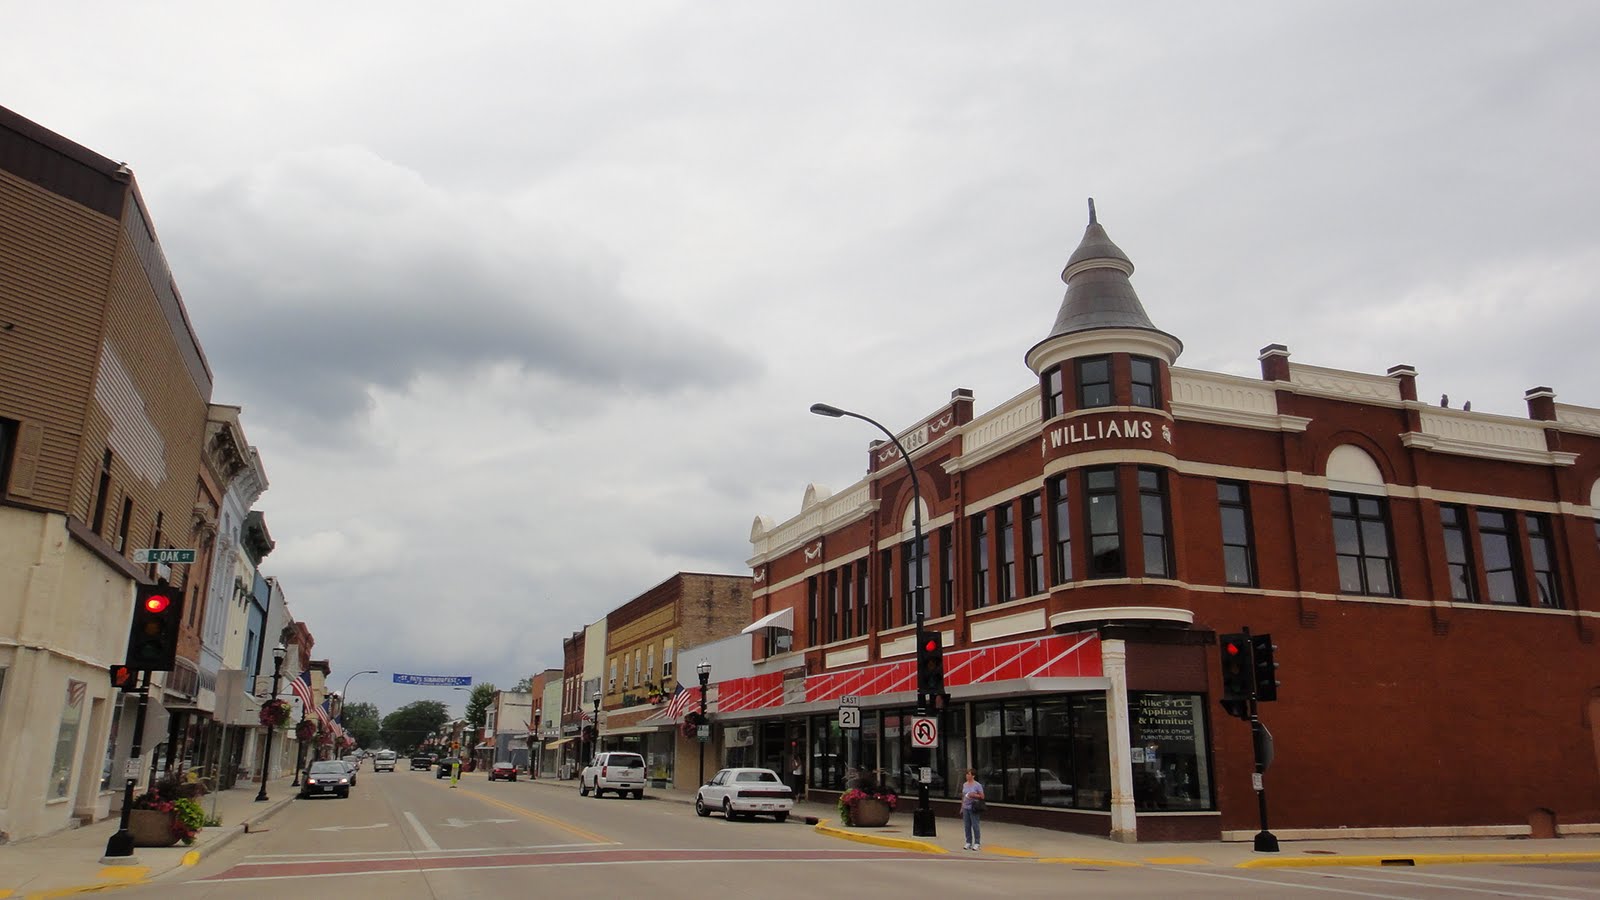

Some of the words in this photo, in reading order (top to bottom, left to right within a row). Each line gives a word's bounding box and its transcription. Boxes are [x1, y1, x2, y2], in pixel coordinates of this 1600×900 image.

[1050, 420, 1152, 448] WILLIAMS
[902, 430, 923, 450] 1896
[160, 551, 179, 561] OAK
[841, 696, 857, 704] EAST
[1139, 699, 1170, 707] Mike's
[1142, 708, 1188, 716] Appliance
[842, 711, 856, 724] 21
[1138, 717, 1147, 725] &
[1149, 717, 1194, 725] Furniture
